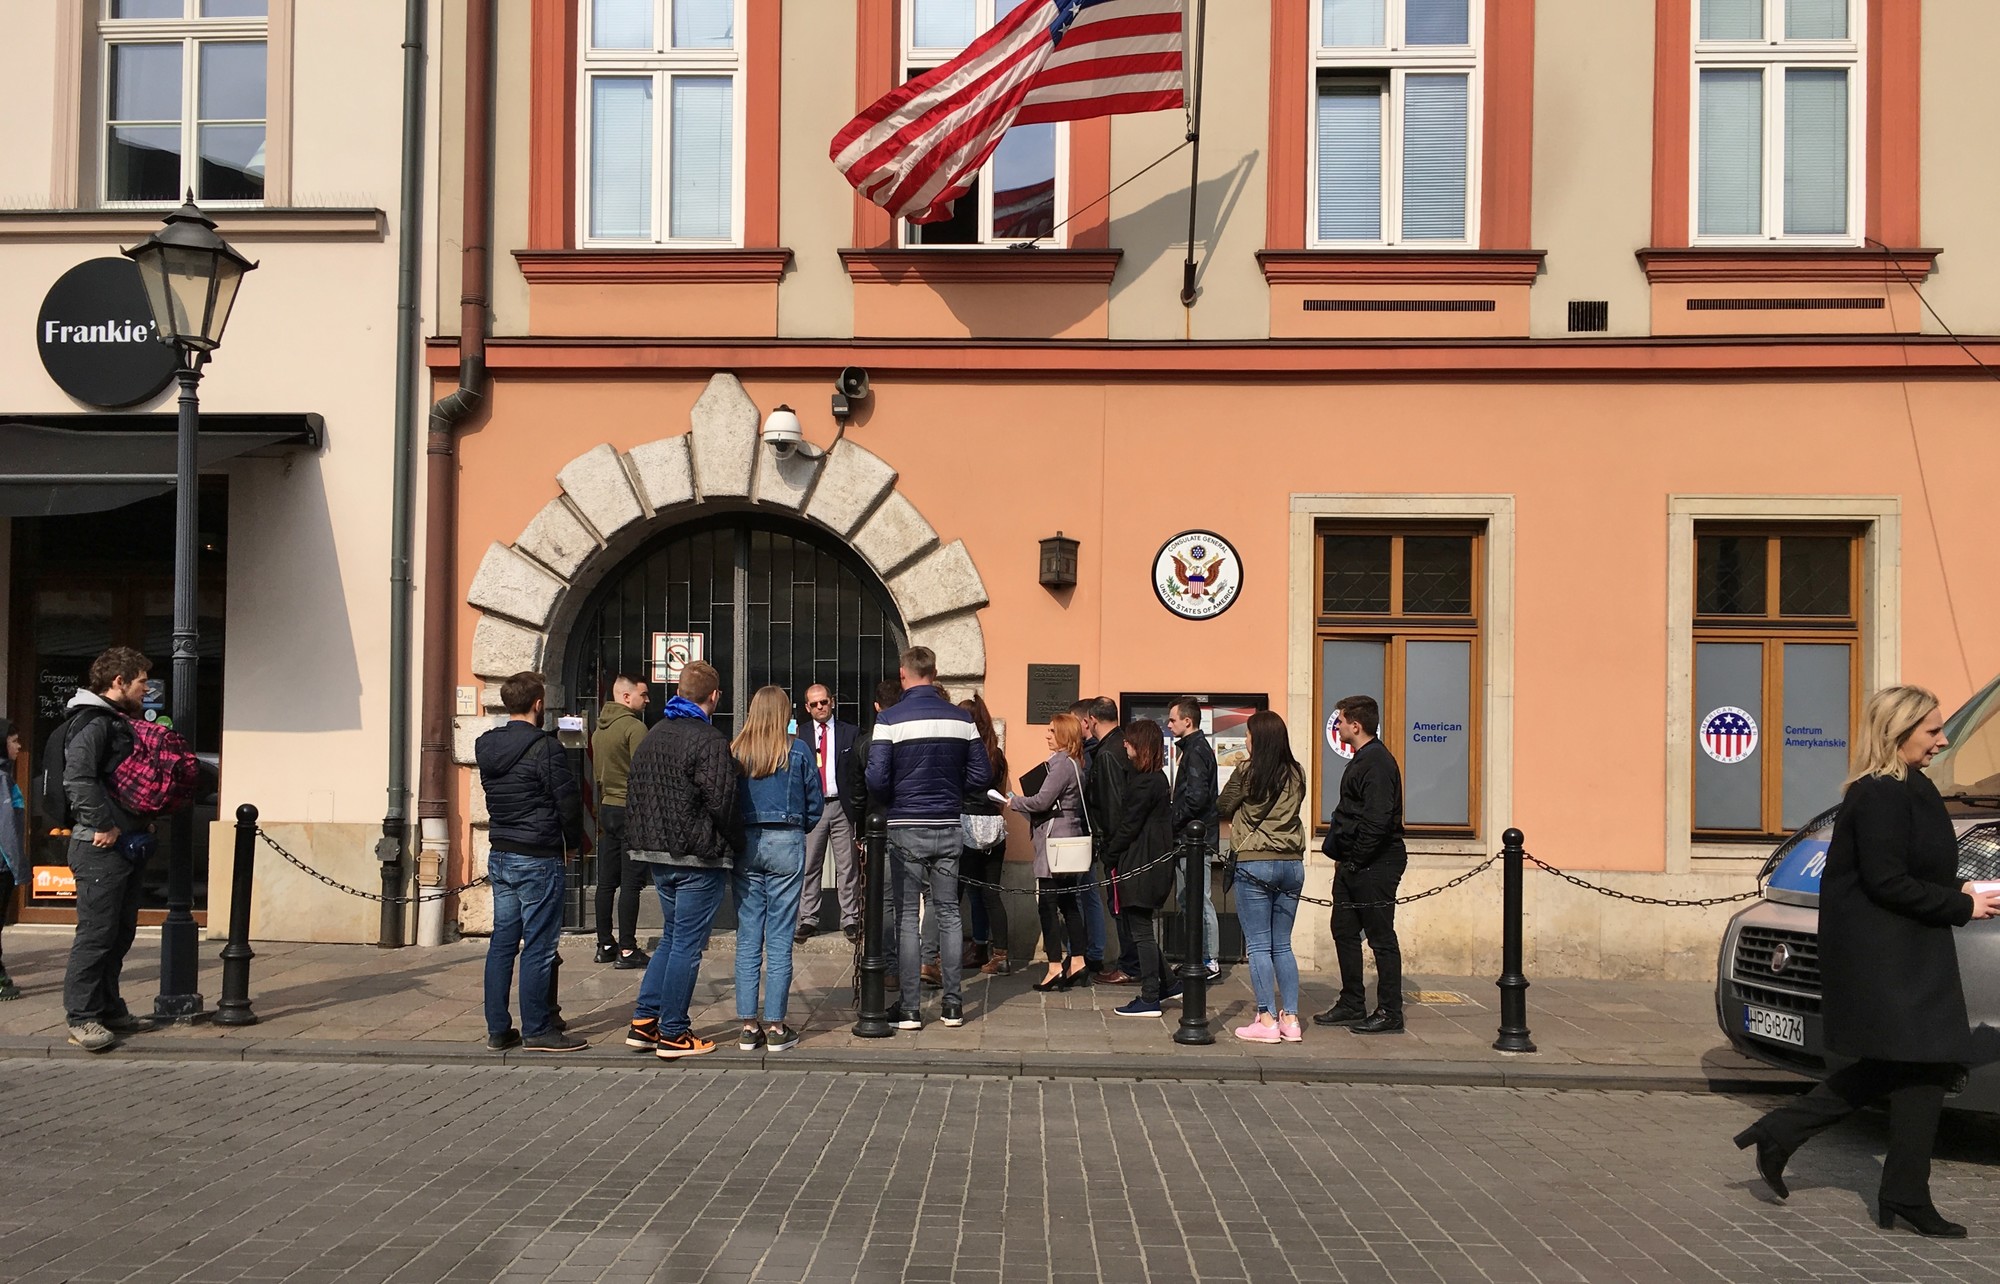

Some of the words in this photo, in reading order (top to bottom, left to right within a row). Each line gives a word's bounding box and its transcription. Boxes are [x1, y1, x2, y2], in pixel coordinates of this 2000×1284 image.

[45, 319, 160, 343] Frankie'
[1167, 535, 1201, 552] CONSULATE
[1202, 536, 1228, 553] GENERAL
[1159, 583, 1176, 606] UNITED
[1176, 603, 1202, 614] STATES
[1213, 585, 1235, 610] AMERICA
[1327, 710, 1339, 730] AMER
[1413, 721, 1462, 731] American
[1701, 707, 1733, 734] AMERICAN
[1736, 709, 1757, 736] CENTER
[1785, 725, 1823, 735] Centrum
[1413, 733, 1447, 743] Center
[1785, 737, 1847, 749] Amerykańskie
[1335, 747, 1351, 758] KRA
